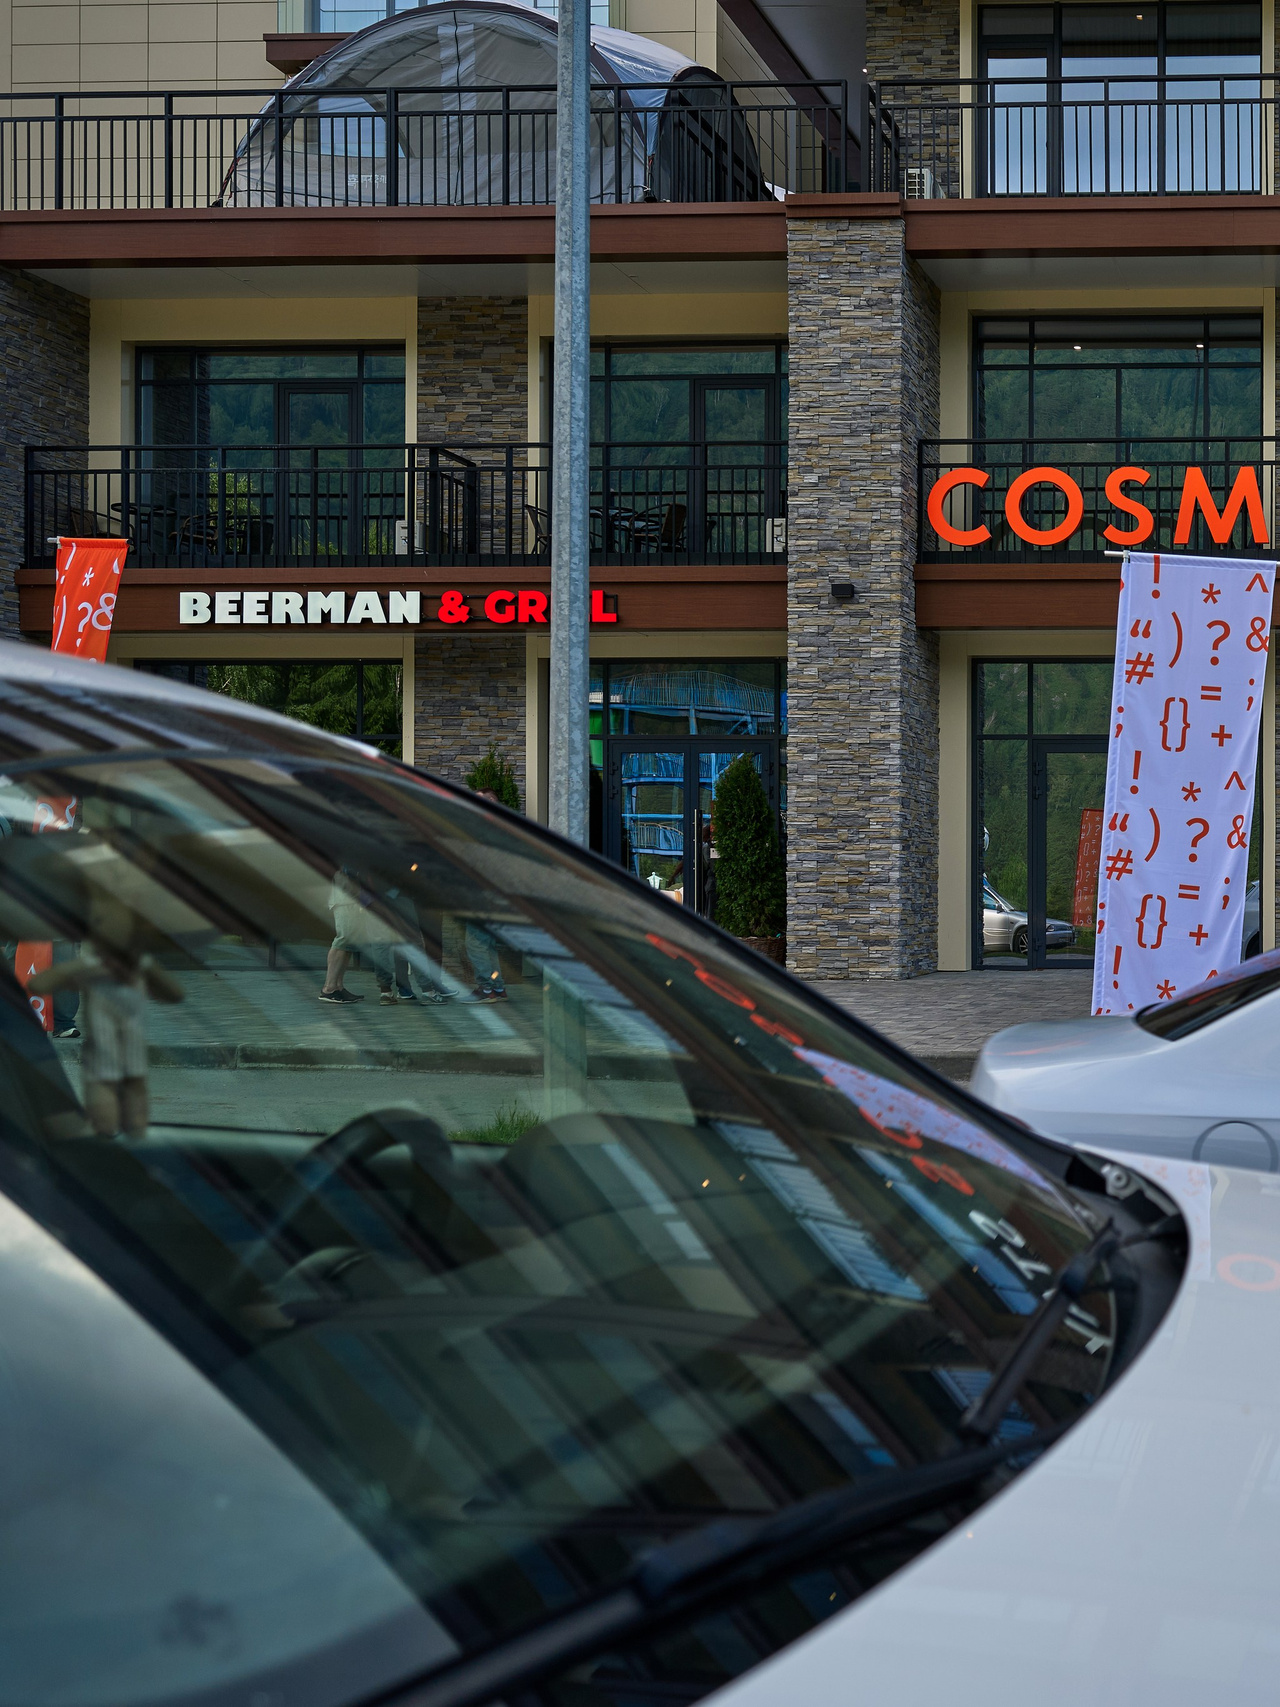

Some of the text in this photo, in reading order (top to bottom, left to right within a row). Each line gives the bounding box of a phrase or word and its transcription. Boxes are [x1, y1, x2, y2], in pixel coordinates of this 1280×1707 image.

[179, 590, 617, 624] BEERMAN & GRL
